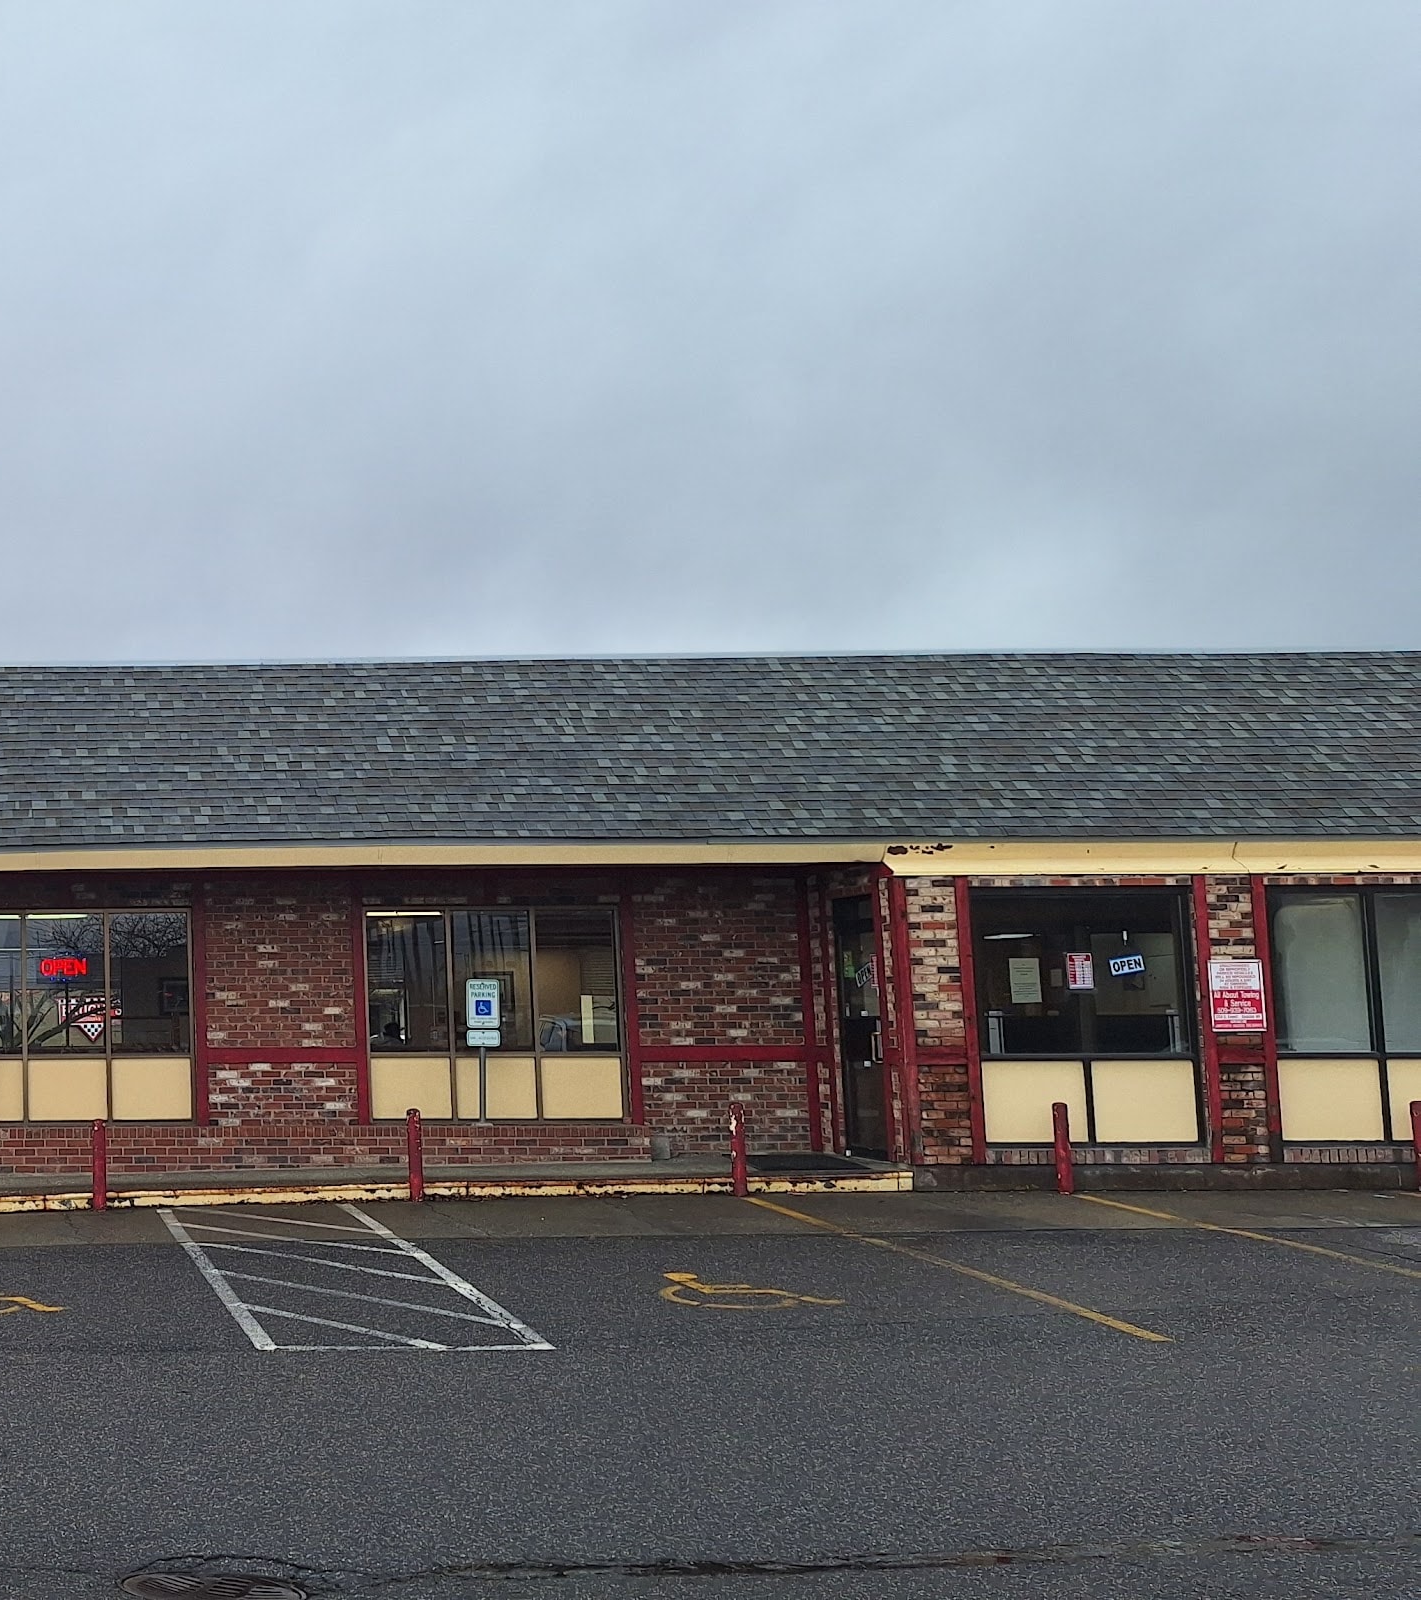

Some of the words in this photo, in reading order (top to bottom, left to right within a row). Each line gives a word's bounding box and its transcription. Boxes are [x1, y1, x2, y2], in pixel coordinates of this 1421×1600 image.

[40, 957, 88, 976] OPEN
[1112, 957, 1142, 973] OPEN
[1223, 991, 1239, 999] About
[1240, 990, 1260, 1000] Towing
[1230, 999, 1252, 1007] Service
